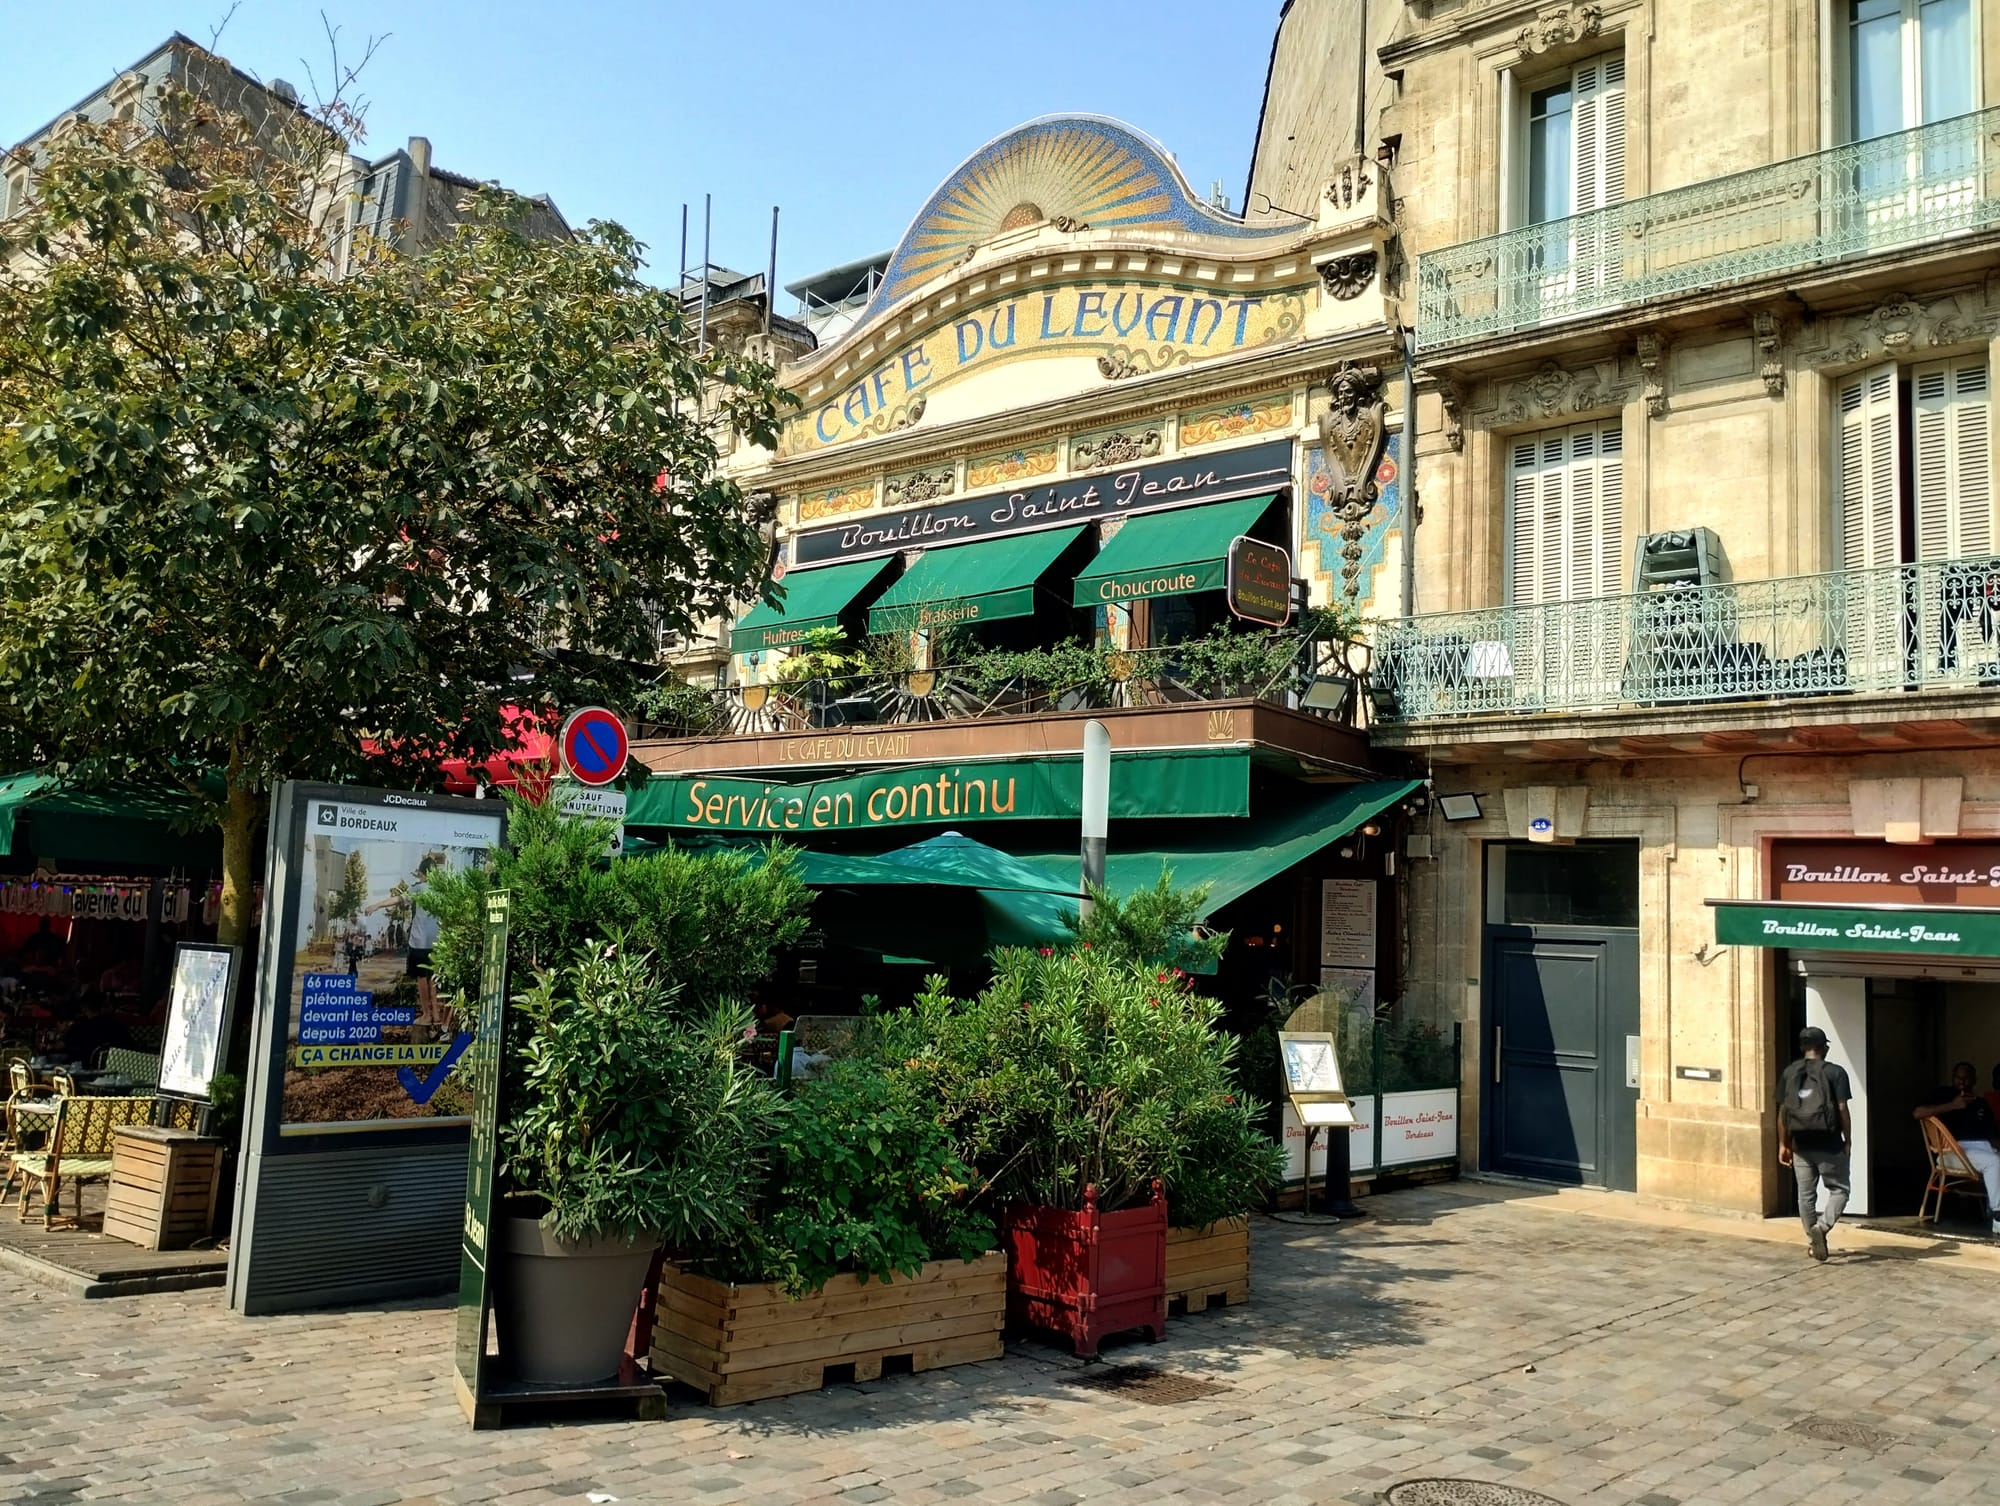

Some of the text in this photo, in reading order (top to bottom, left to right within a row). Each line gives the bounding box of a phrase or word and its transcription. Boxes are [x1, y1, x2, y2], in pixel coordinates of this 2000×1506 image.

[816, 291, 1265, 442] CAFE DU LEVANT
[840, 471, 1222, 549] Bouillon Saint Jean
[1244, 551, 1257, 565] Le
[1099, 573, 1196, 600] Choucroute
[1237, 589, 1260, 603] Bouillon
[1260, 595, 1274, 608] Saint
[920, 602, 980, 625] Brasserie
[779, 740, 796, 761] LE
[837, 737, 855, 758] DU
[858, 733, 913, 758] LEVANT
[383, 794, 427, 807] JCDecaux
[579, 792, 603, 802] SAUF
[686, 768, 1015, 829] Service en continu
[341, 806, 367, 816] Ville de
[556, 799, 624, 815] ANUTENTIONS
[340, 817, 398, 832] BORDEAUX
[1786, 864, 1891, 883] Bouillon
[124, 894, 142, 914] du
[1762, 920, 1961, 943] Bouillon Saint-Jean
[307, 976, 352, 989] 66 rues
[305, 992, 368, 1008] piétonnes
[303, 1009, 411, 1022] devant les écoles
[302, 1026, 377, 1041] depuis 2020
[301, 1047, 442, 1065] ÇA CHANGE LA VIE
[1384, 1110, 1453, 1127] Bouillon Saint-Jean
[470, 1208, 485, 1250] Jean
